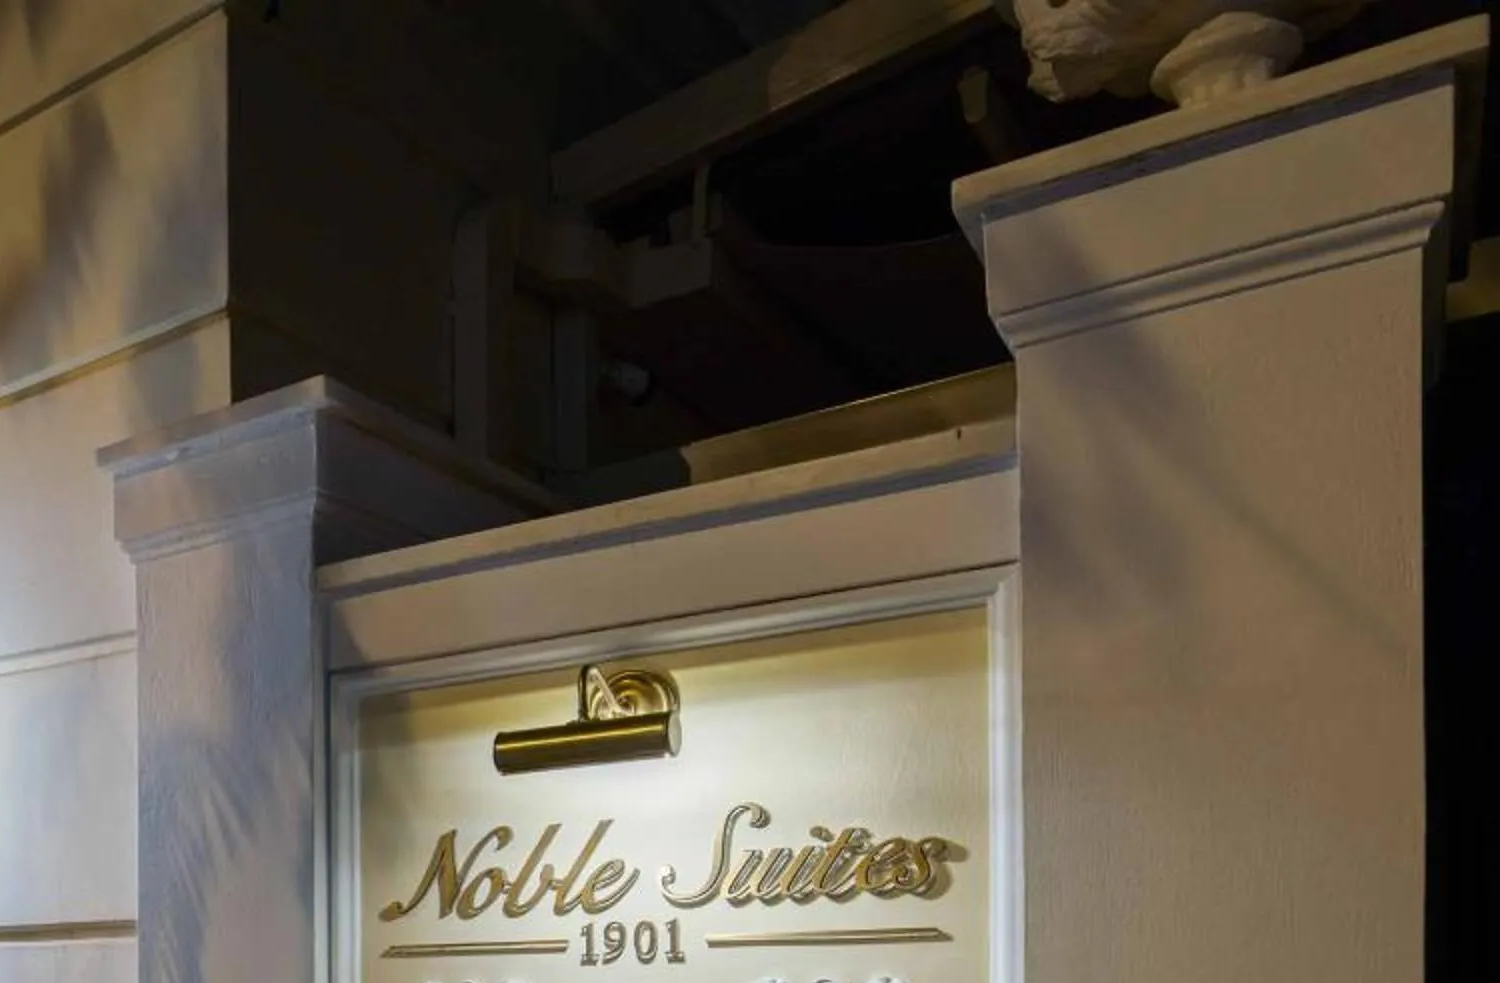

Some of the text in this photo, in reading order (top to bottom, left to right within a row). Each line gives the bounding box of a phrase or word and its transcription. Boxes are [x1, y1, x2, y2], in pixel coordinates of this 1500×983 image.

[379, 801, 962, 920] Noble Suites
[580, 919, 684, 965] 1901
